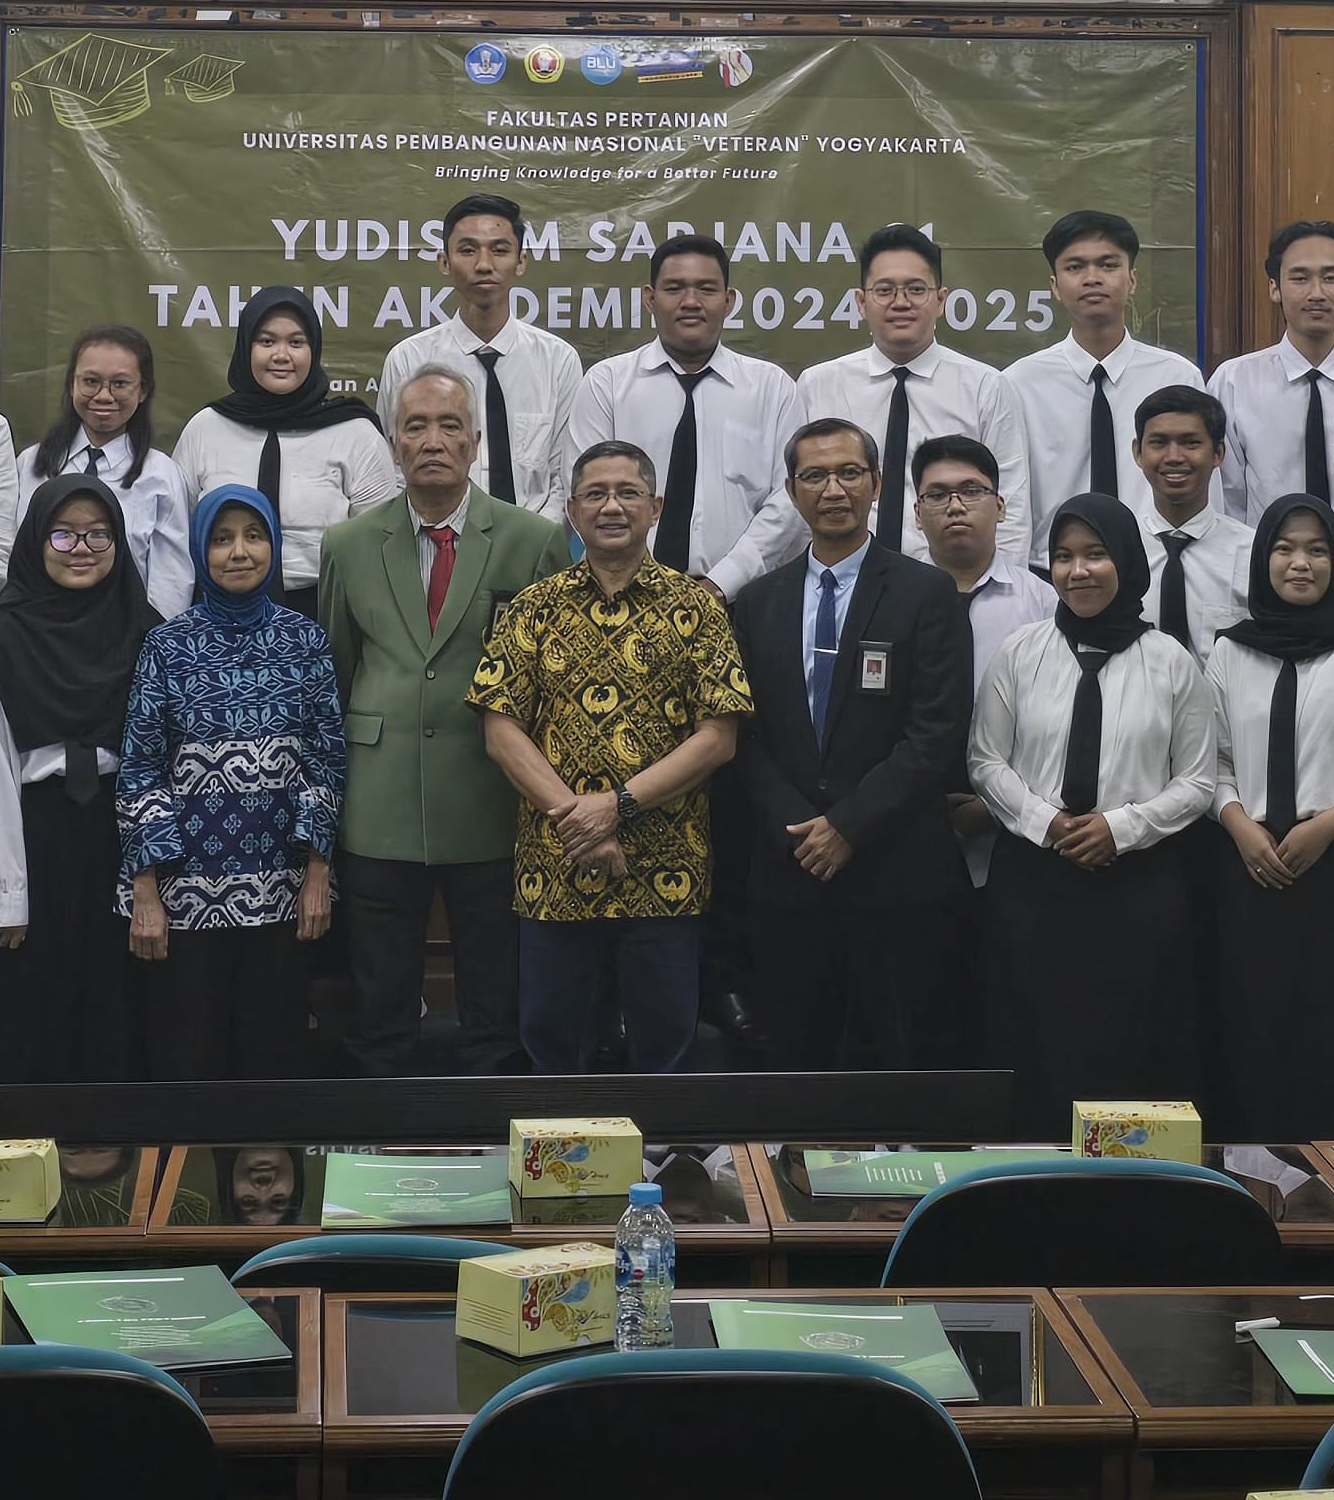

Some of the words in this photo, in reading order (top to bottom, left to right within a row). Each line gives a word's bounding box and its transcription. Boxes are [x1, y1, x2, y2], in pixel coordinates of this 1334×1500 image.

[486, 110, 598, 128] FAKULTAS
[605, 111, 729, 128] PERTANIAN
[243, 132, 388, 150] UNIVERSITAS
[395, 133, 567, 151] PEMBANGUNAN
[574, 135, 687, 152] NASIONAL
[817, 136, 967, 154] YOGYAKARTA
[434, 165, 510, 181] Bringing
[617, 166, 642, 180] for
[647, 169, 657, 179] a
[148, 285, 349, 328] TAHN
